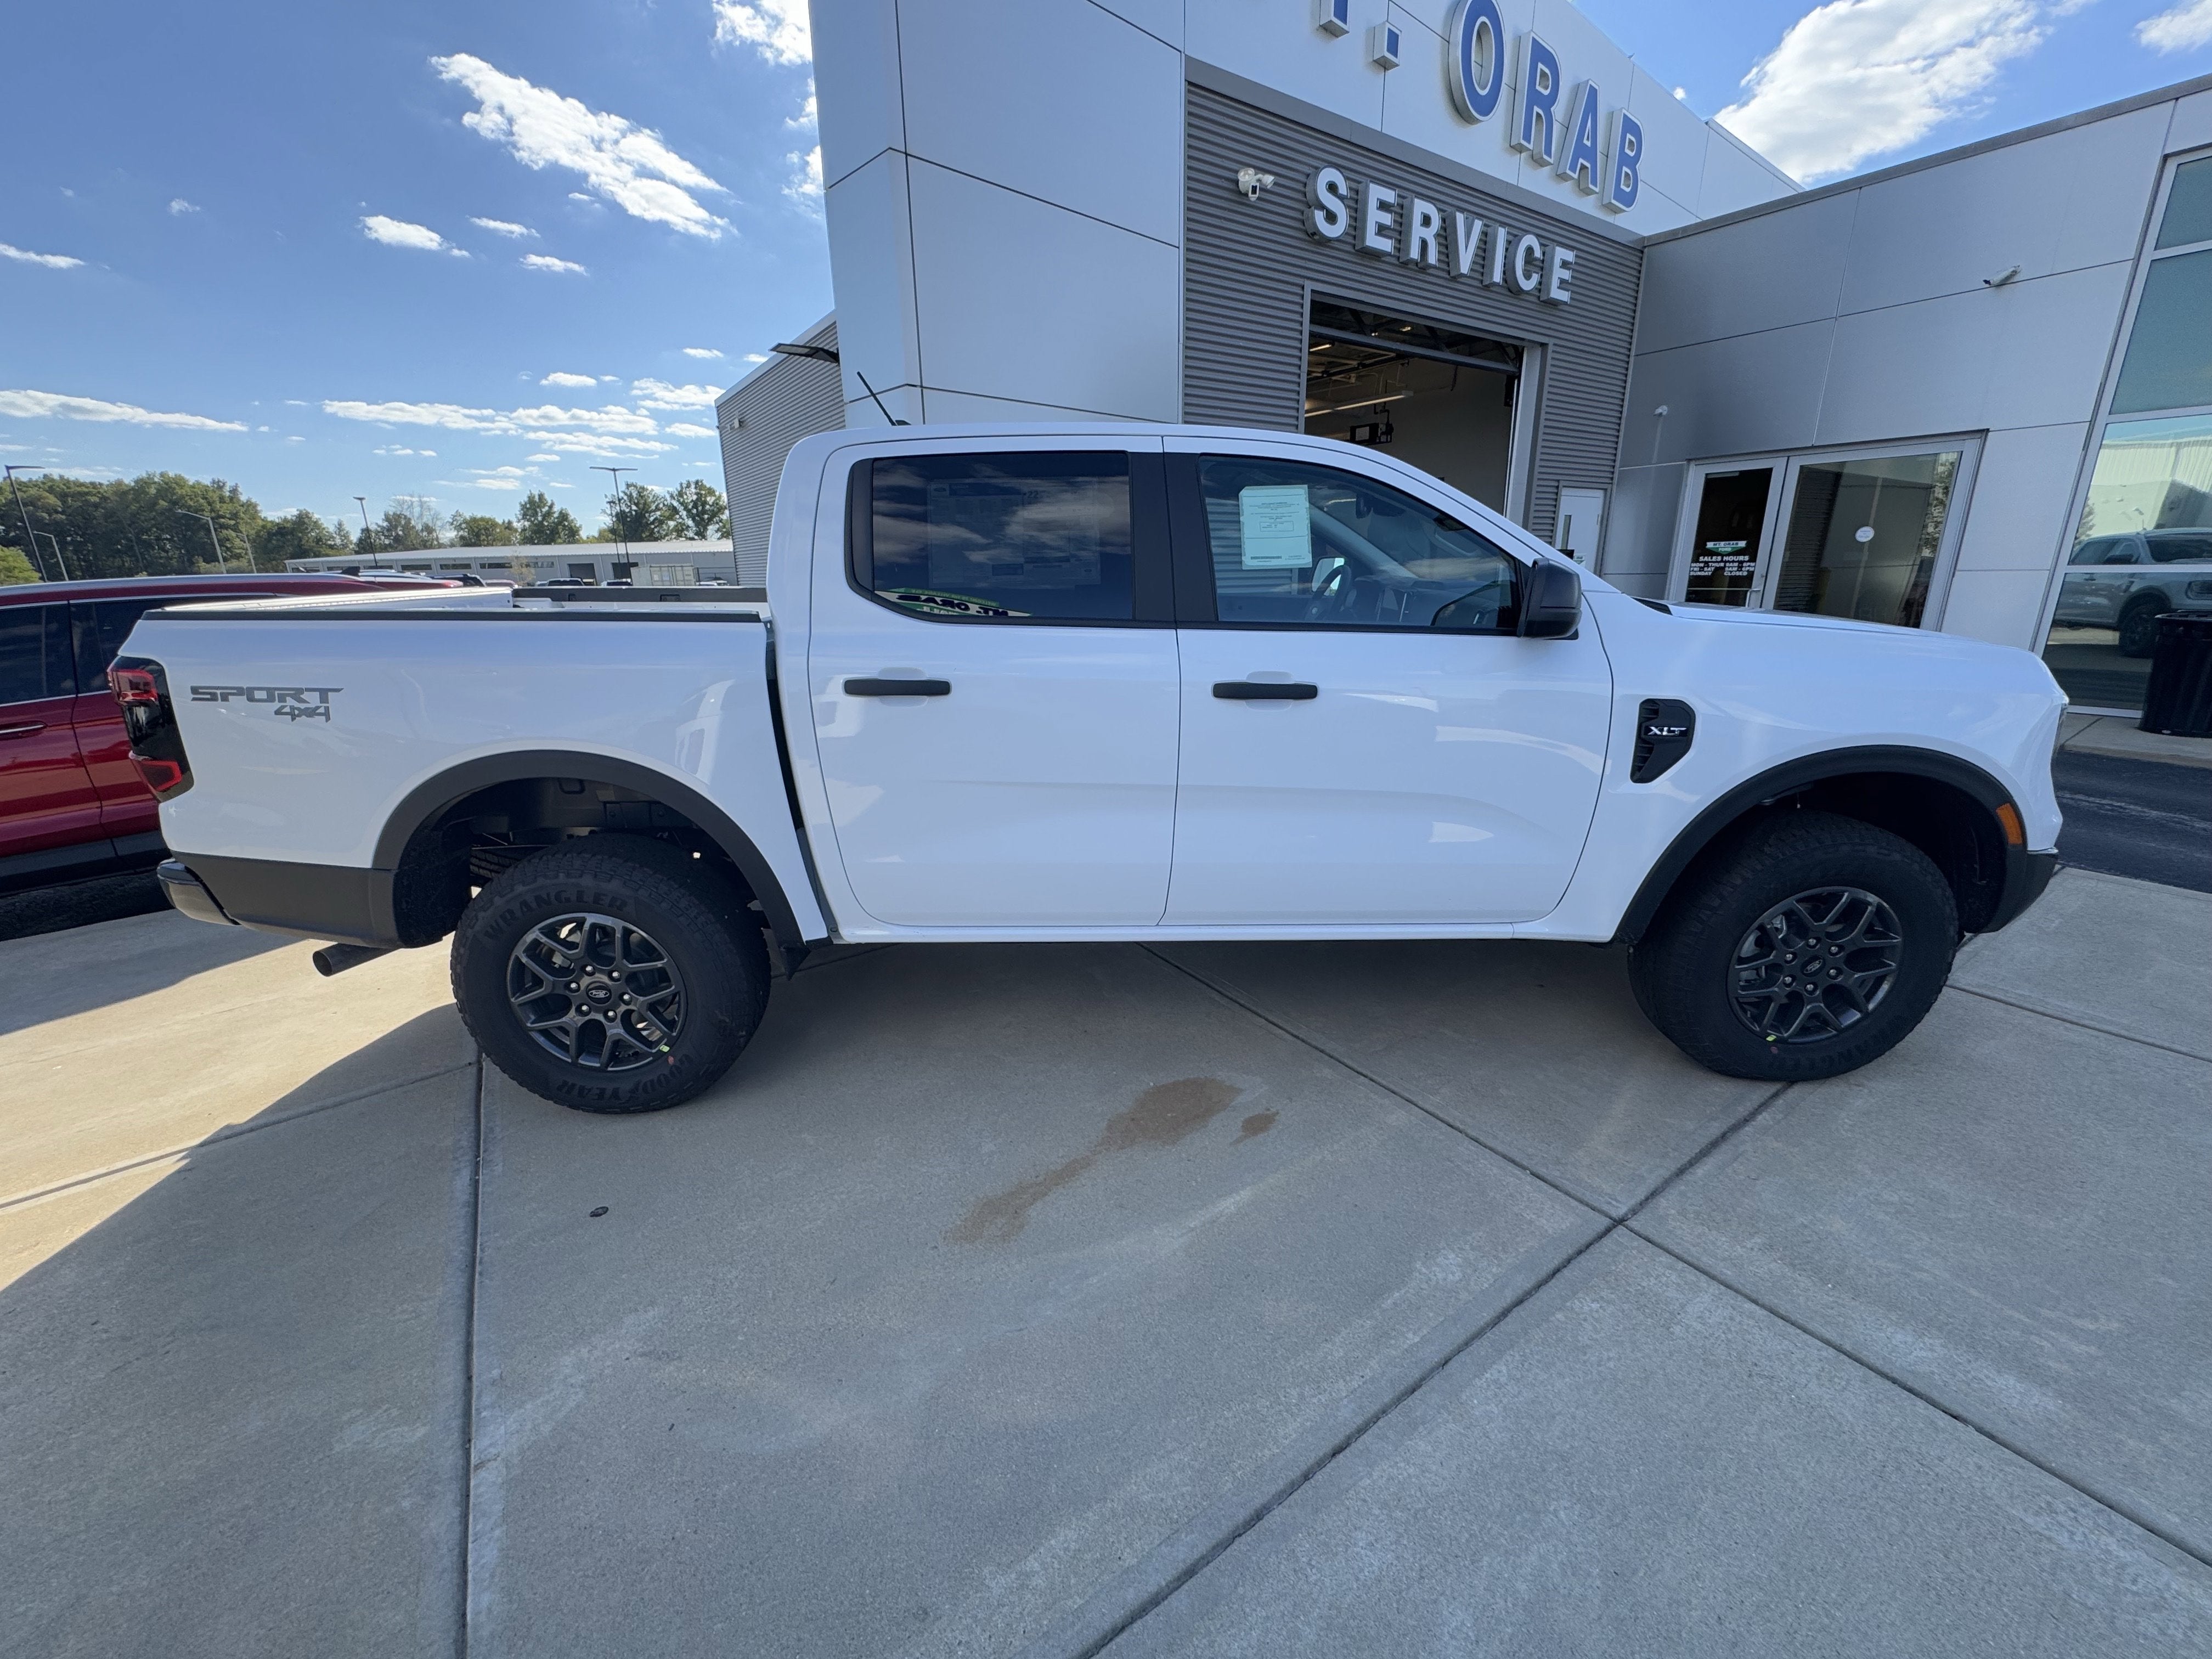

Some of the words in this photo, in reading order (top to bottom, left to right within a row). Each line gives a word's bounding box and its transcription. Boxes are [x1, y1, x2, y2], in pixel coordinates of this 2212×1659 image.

[1449, 0, 1644, 213] ORAB
[1304, 165, 1576, 306] SERVICE
[190, 685, 345, 704] SPORT
[1647, 726, 1687, 736] XLT
[483, 889, 630, 943] WRANGLER
